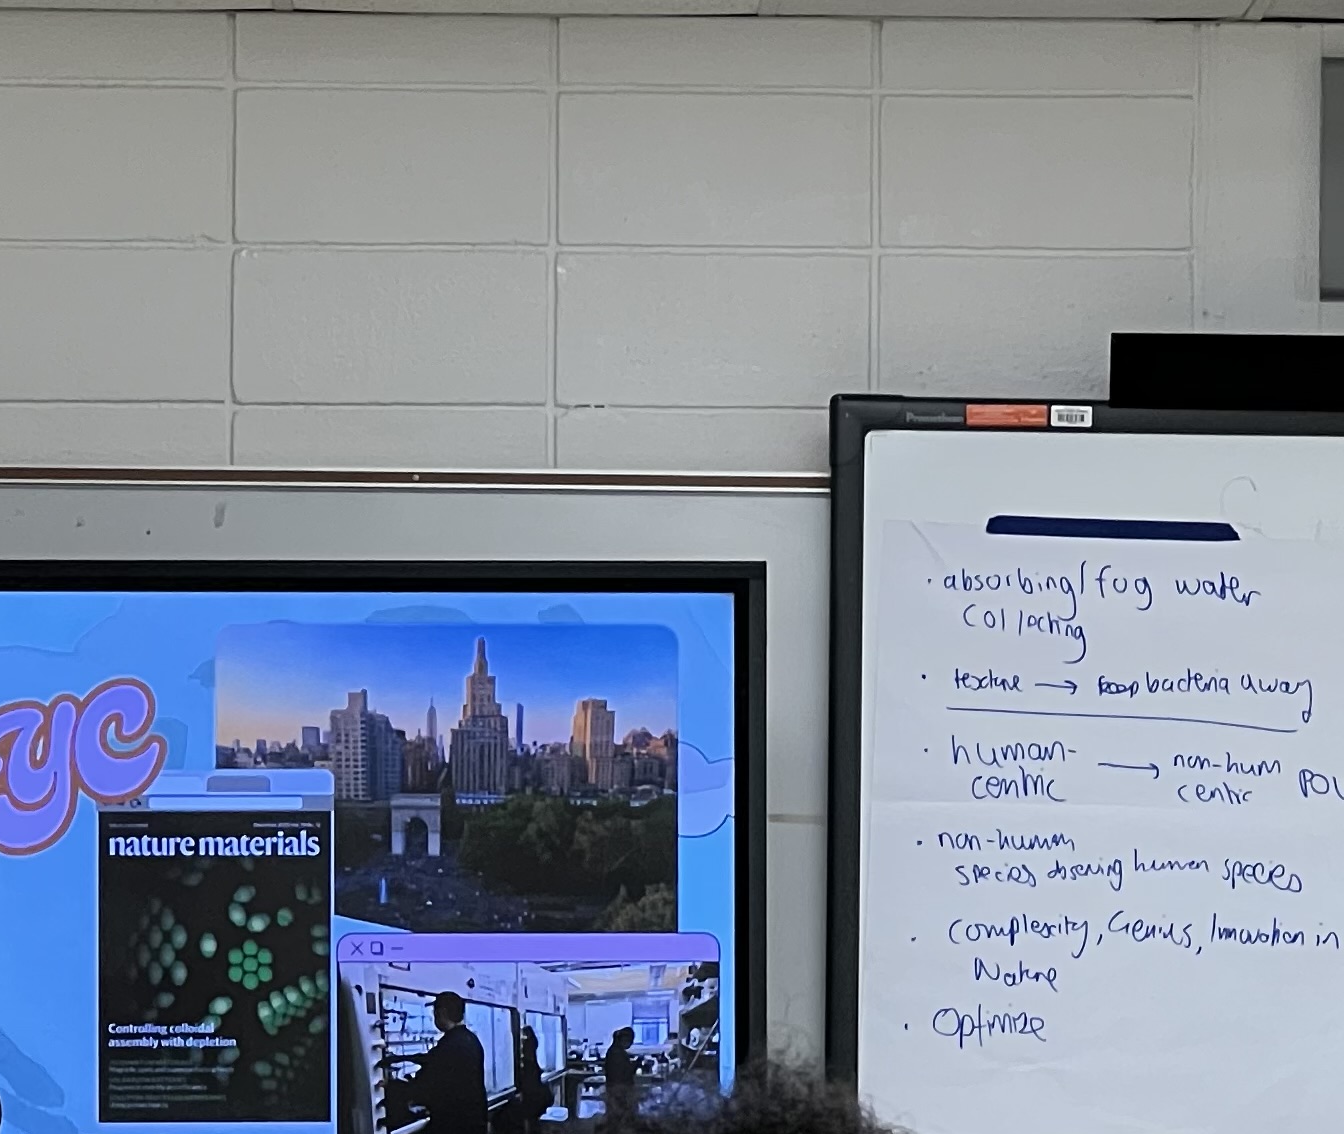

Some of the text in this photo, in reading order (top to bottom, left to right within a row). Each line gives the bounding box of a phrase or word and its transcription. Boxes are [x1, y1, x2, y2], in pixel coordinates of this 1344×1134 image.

[1174, 571, 1262, 607] water
[1145, 668, 1230, 695] bacteria
[1240, 674, 1313, 723] away
[972, 765, 1067, 802] centric
[109, 830, 321, 856] nature materials
[938, 828, 1075, 851] non-human
[955, 863, 1037, 888] species
[1221, 858, 1303, 893] species
[1316, 922, 1340, 949] in
[108, 1022, 214, 1035] Controlling colloidal
[108, 1036, 237, 1048] assembly with depletion
[932, 1003, 1046, 1050] Optimize
